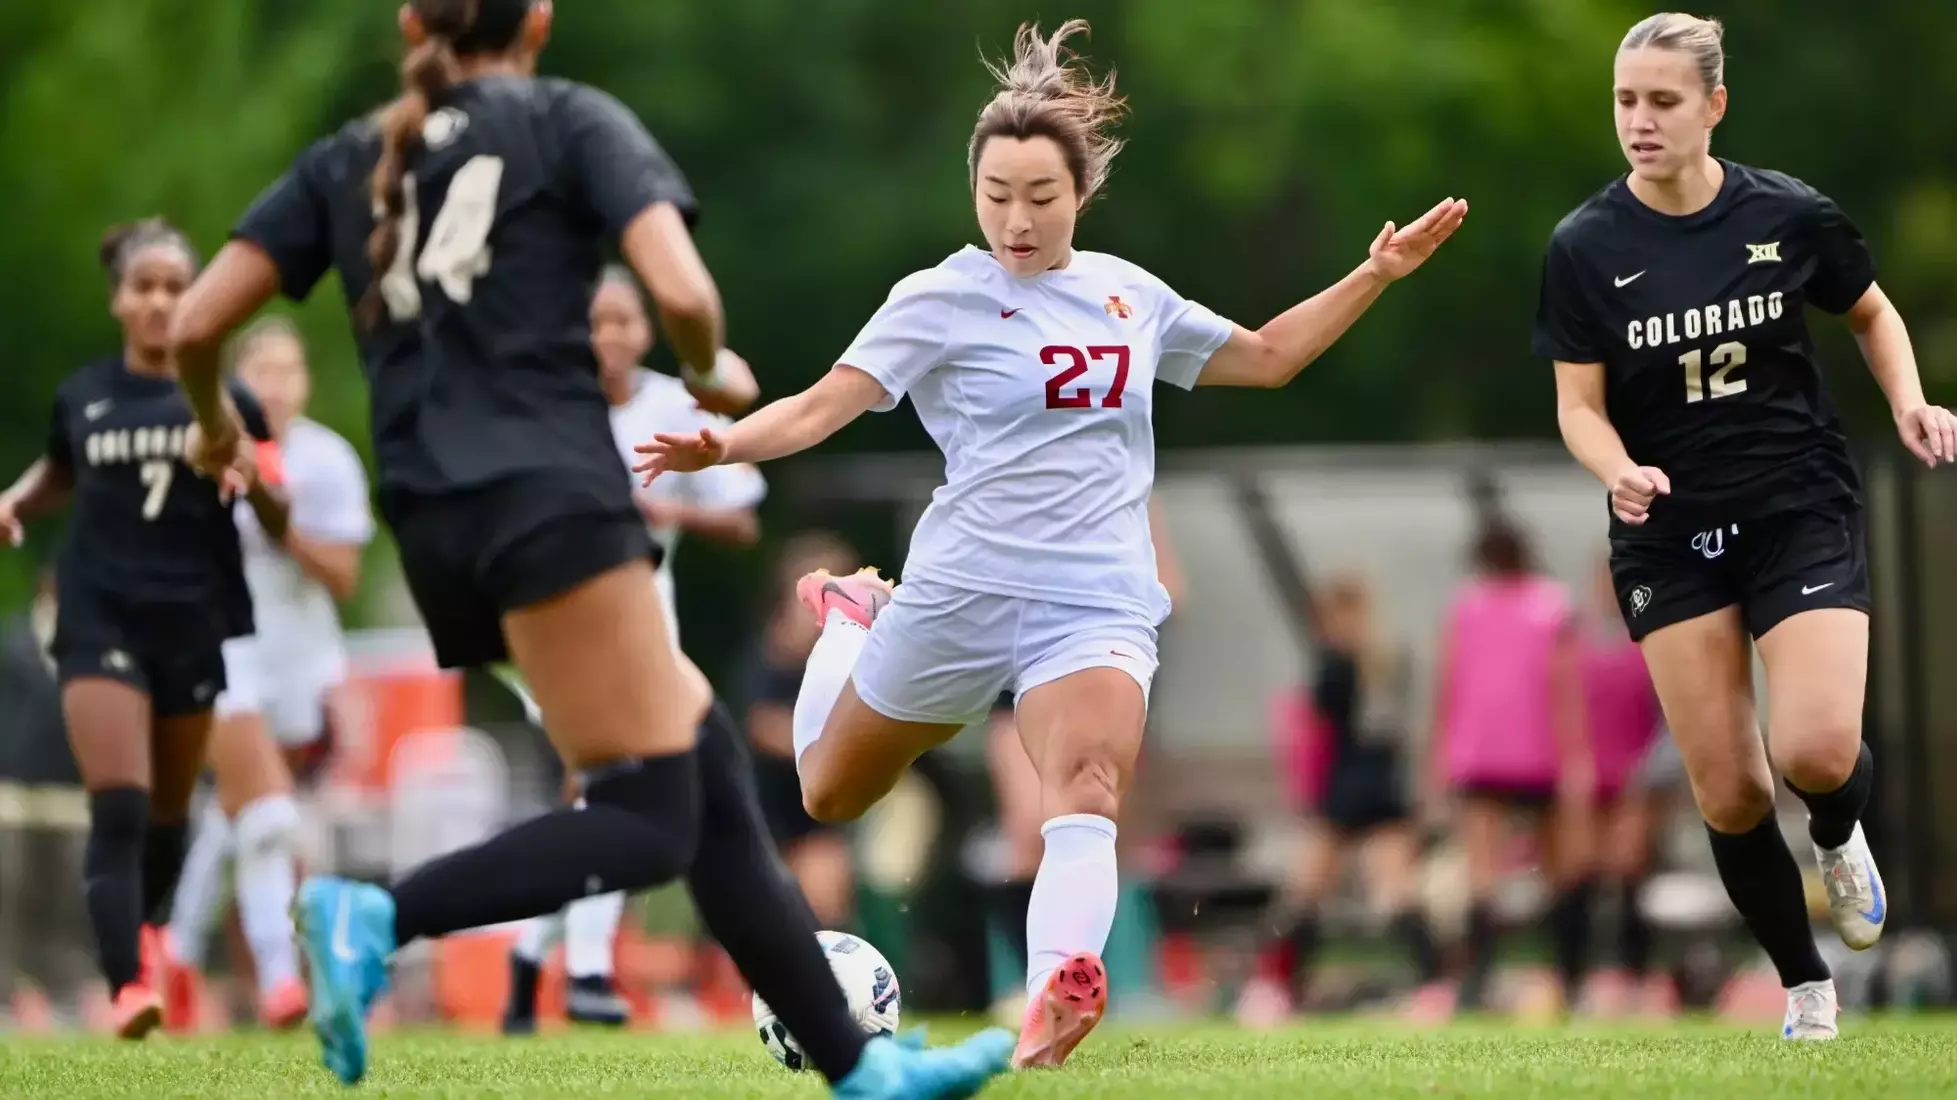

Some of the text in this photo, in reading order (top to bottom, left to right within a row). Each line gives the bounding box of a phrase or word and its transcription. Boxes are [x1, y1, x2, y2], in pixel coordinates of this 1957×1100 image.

[1627, 291, 1783, 350] COLORADO
[1039, 345, 1130, 409] 27
[1678, 340, 1748, 403] 12
[86, 424, 185, 467] COLORA
[140, 460, 174, 521] 7
